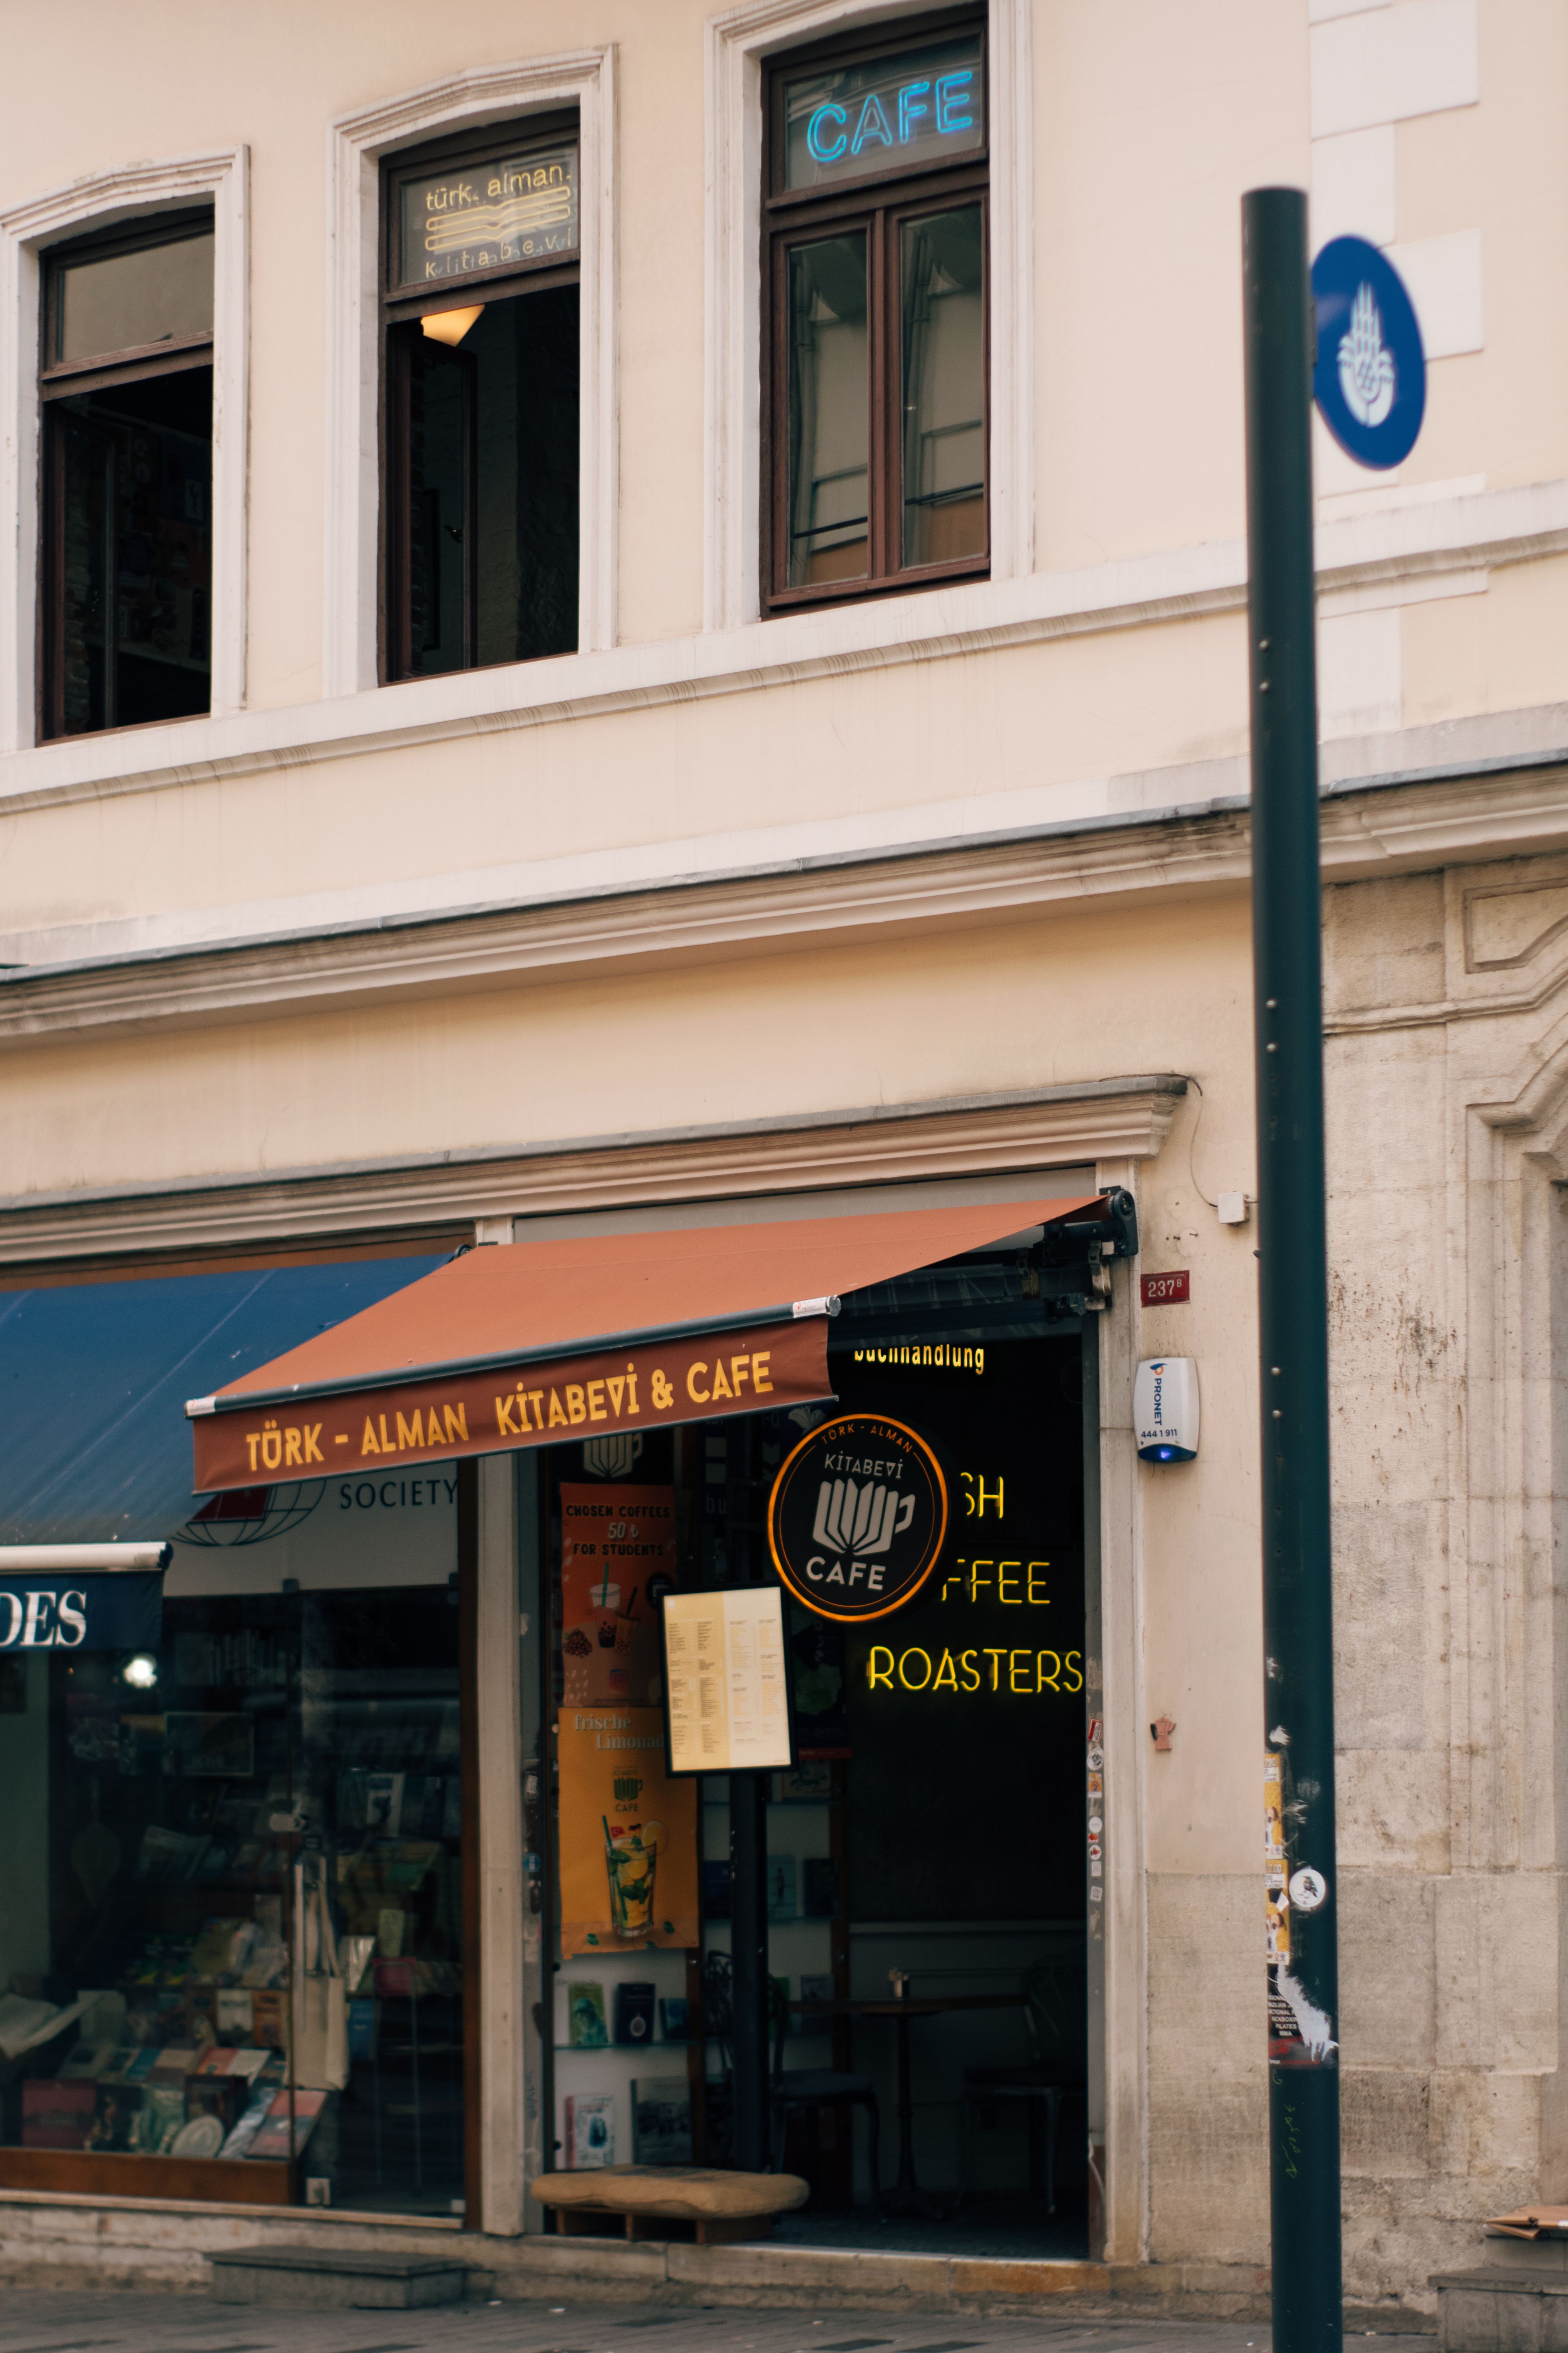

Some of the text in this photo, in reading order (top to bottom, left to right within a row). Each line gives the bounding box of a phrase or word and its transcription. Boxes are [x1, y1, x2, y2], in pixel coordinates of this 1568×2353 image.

[807, 71, 972, 162] CAFE
[487, 165, 572, 197] alman.
[246, 1420, 325, 1471] TÜRK
[361, 1402, 470, 1455] ALMAN
[495, 1362, 640, 1435] KİTABEVİ
[651, 1368, 674, 1409] &
[687, 1351, 774, 1403] CAFE
[1154, 1378, 1162, 1425] PRONET
[821, 1423, 855, 1444] TÜRK
[870, 1425, 913, 1453] ALMAN
[1165, 1428, 1177, 1437] 911
[824, 1450, 903, 1479] KİTABEVİ
[340, 1479, 458, 1510] SOCIETY
[566, 1505, 670, 1518] CHOSEN COFFEES
[608, 1522, 626, 1539] 50
[573, 1543, 664, 1556] FOR STUDENTS
[806, 1556, 886, 1590] CAFE
[870, 1646, 1083, 1693] ROASTERS
[575, 1714, 632, 1730] frische
[596, 1734, 664, 1750] Limonad
[615, 1803, 639, 1812] CAFE
